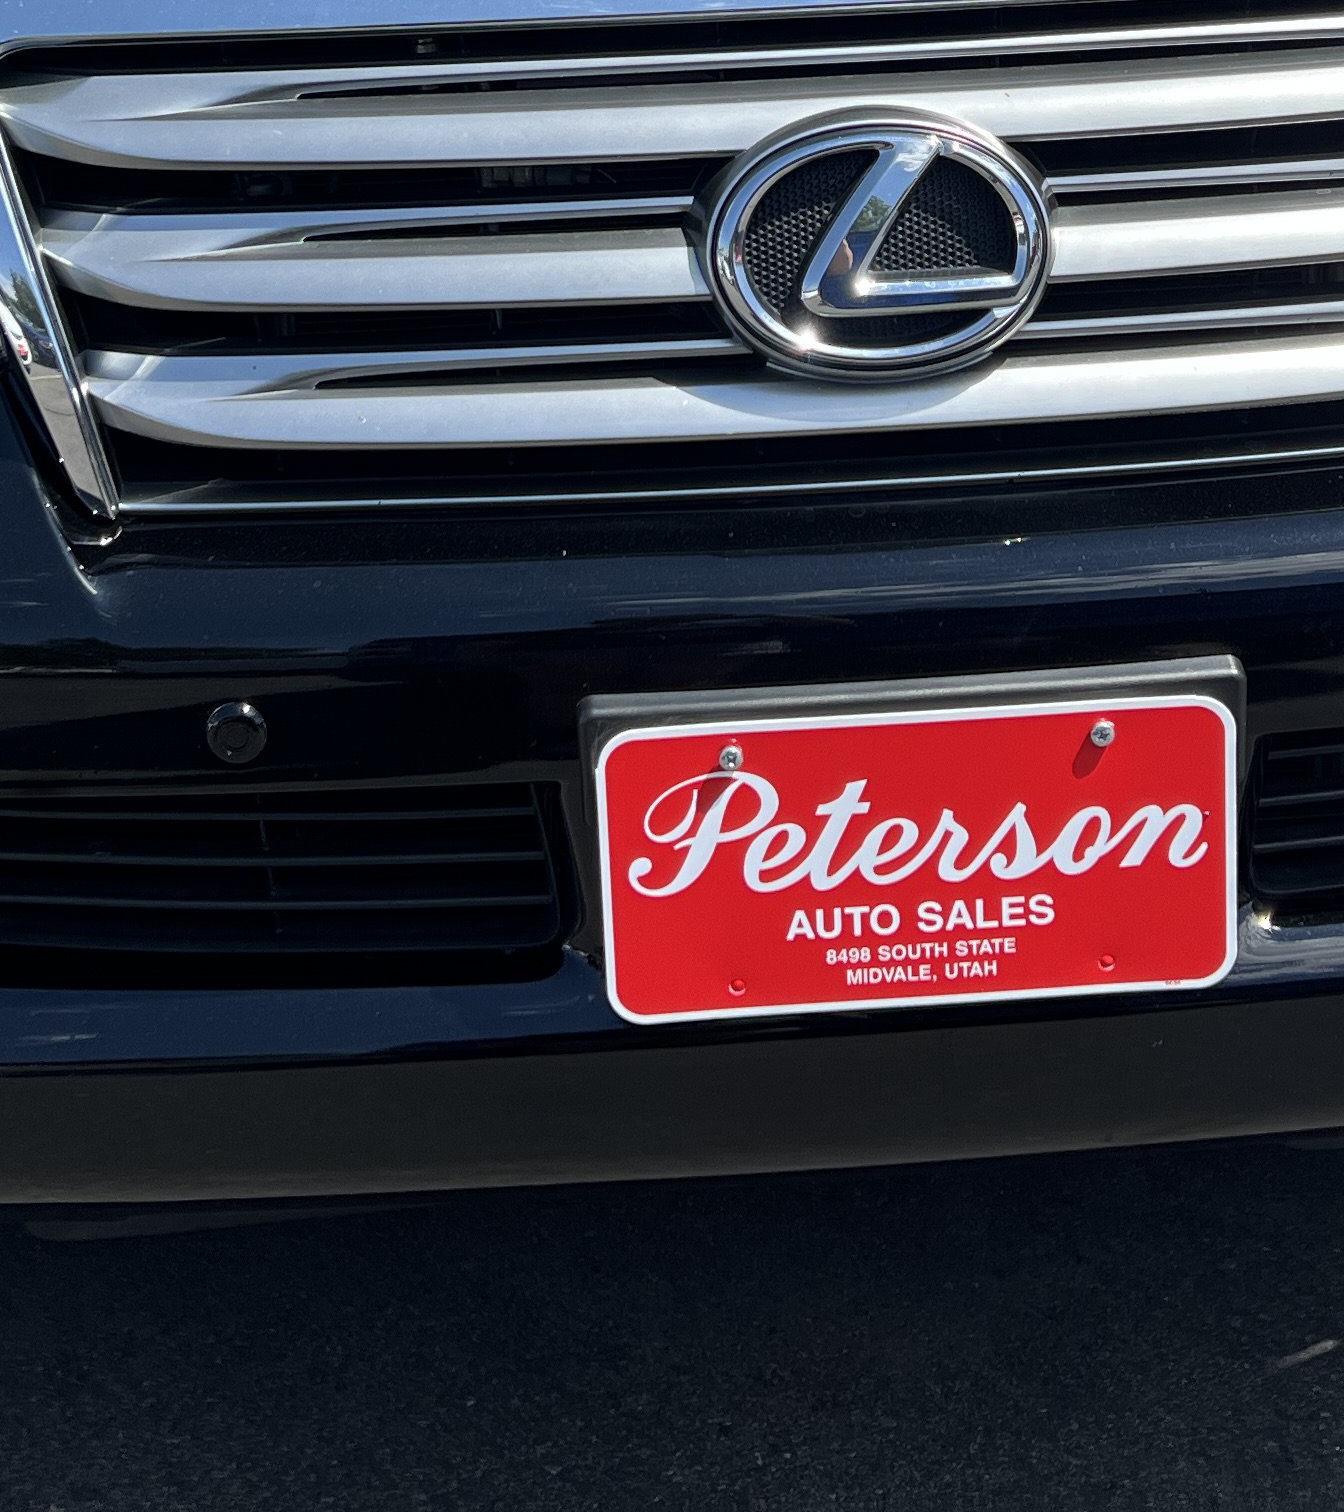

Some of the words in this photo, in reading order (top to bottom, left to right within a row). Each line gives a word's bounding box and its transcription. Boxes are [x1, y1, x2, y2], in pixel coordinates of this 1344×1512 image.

[628, 770, 1209, 898] Peterson
[786, 903, 901, 941] AUTO
[917, 893, 1055, 933] SALES
[825, 946, 872, 965] 8498
[877, 941, 948, 962] SOUTH
[955, 937, 1017, 957] STATE
[846, 964, 937, 985] MIDVALE,
[944, 959, 998, 980] UTAH
